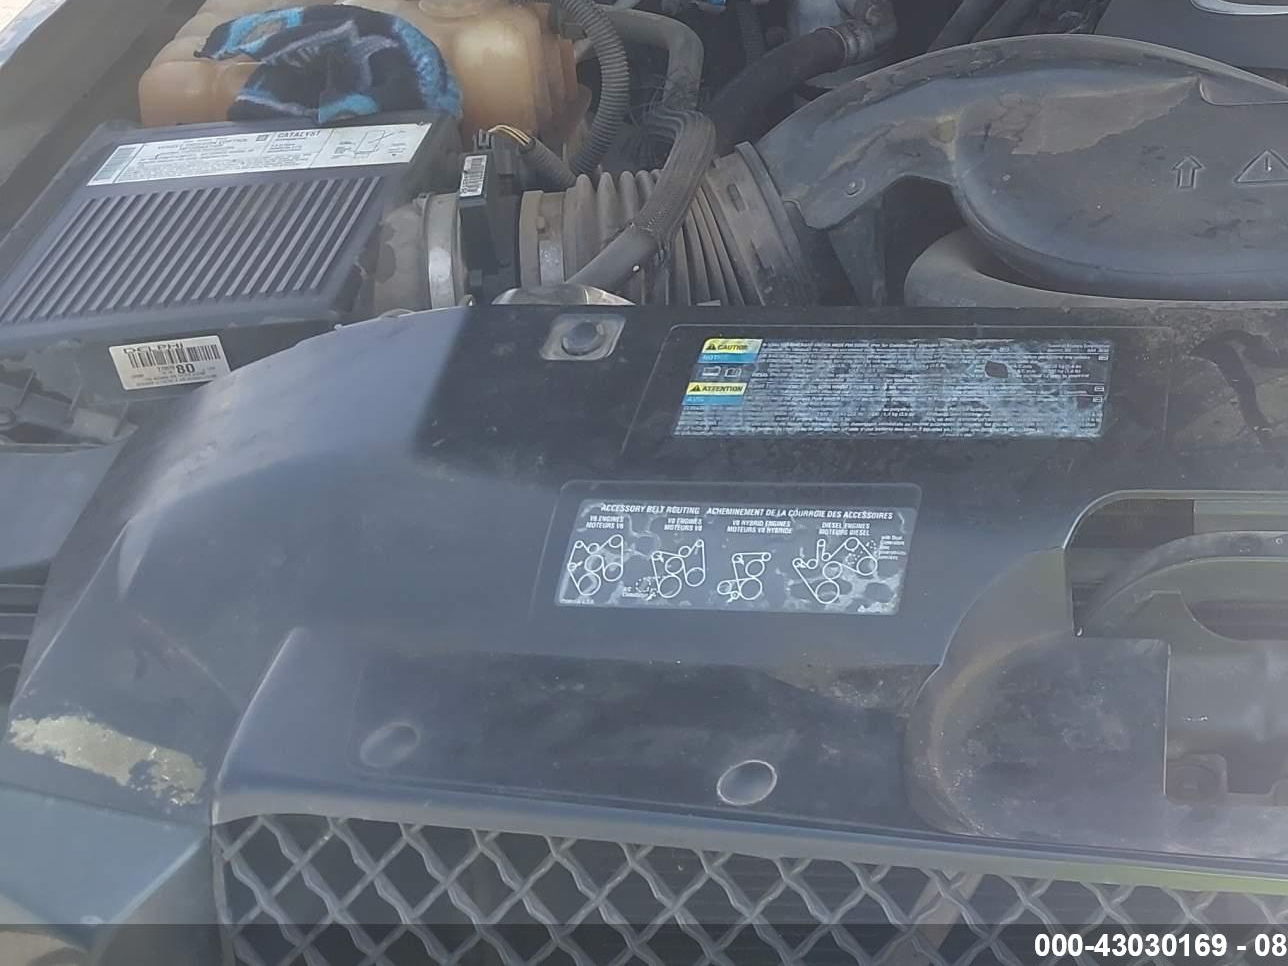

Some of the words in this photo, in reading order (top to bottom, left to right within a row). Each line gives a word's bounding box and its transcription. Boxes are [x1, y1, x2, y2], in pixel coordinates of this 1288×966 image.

[123, 342, 184, 354] DELPHI
[175, 363, 195, 375] 80
[701, 384, 744, 392] ATTENTION
[601, 504, 645, 513] ACCESSORY
[646, 505, 666, 514] BELT
[666, 506, 701, 515] ROUTING
[706, 507, 765, 516] ACHEMINEMENT
[827, 510, 842, 518] DES
[842, 511, 894, 520] ACCESSOIRES
